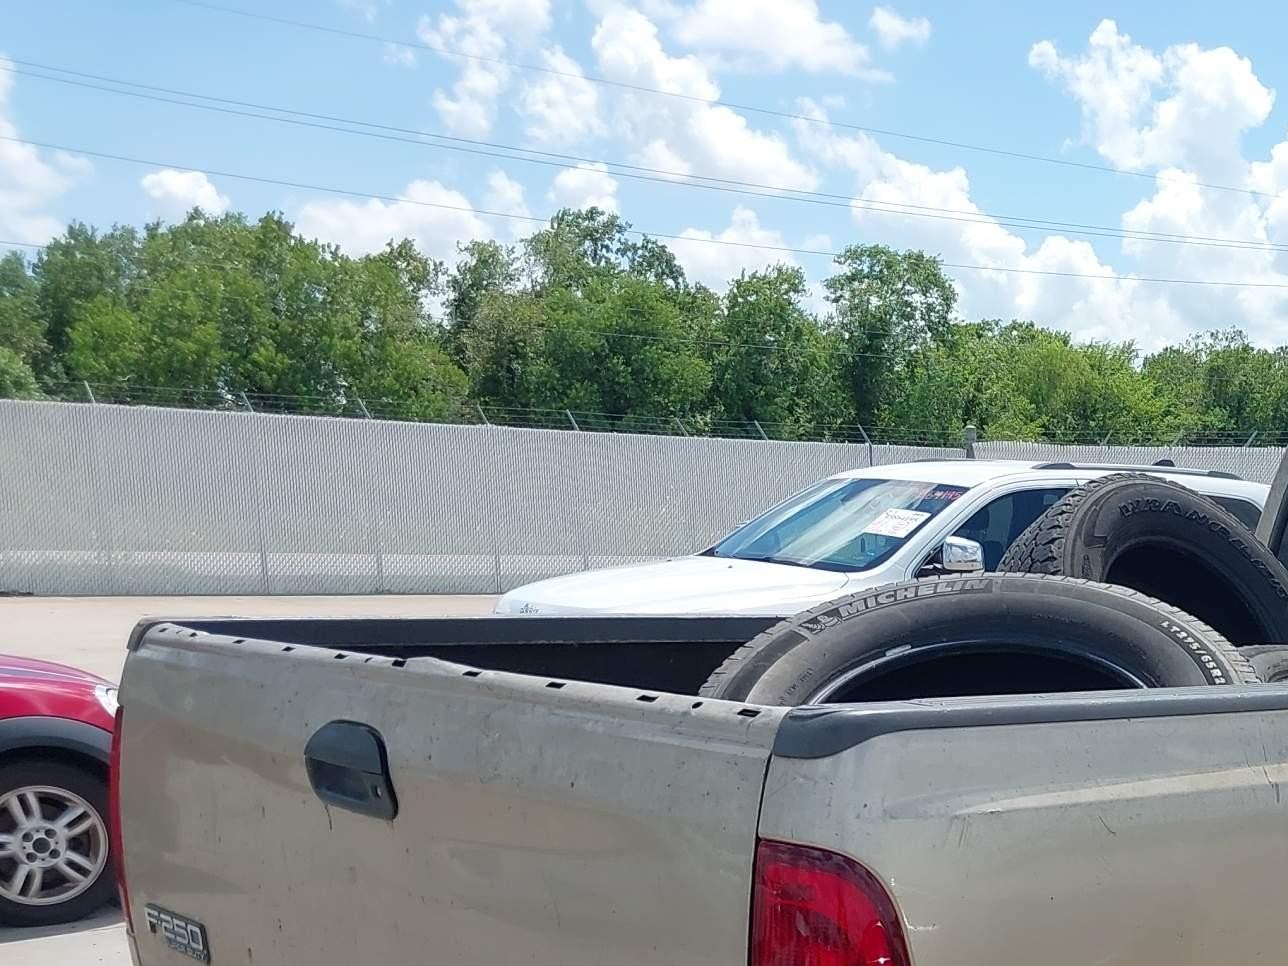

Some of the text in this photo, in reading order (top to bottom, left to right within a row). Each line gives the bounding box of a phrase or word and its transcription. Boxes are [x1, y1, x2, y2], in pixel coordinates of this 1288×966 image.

[838, 579, 989, 618] MICHELIN
[1160, 620, 1226, 684] LT275/65R2
[144, 907, 204, 952] F-250
